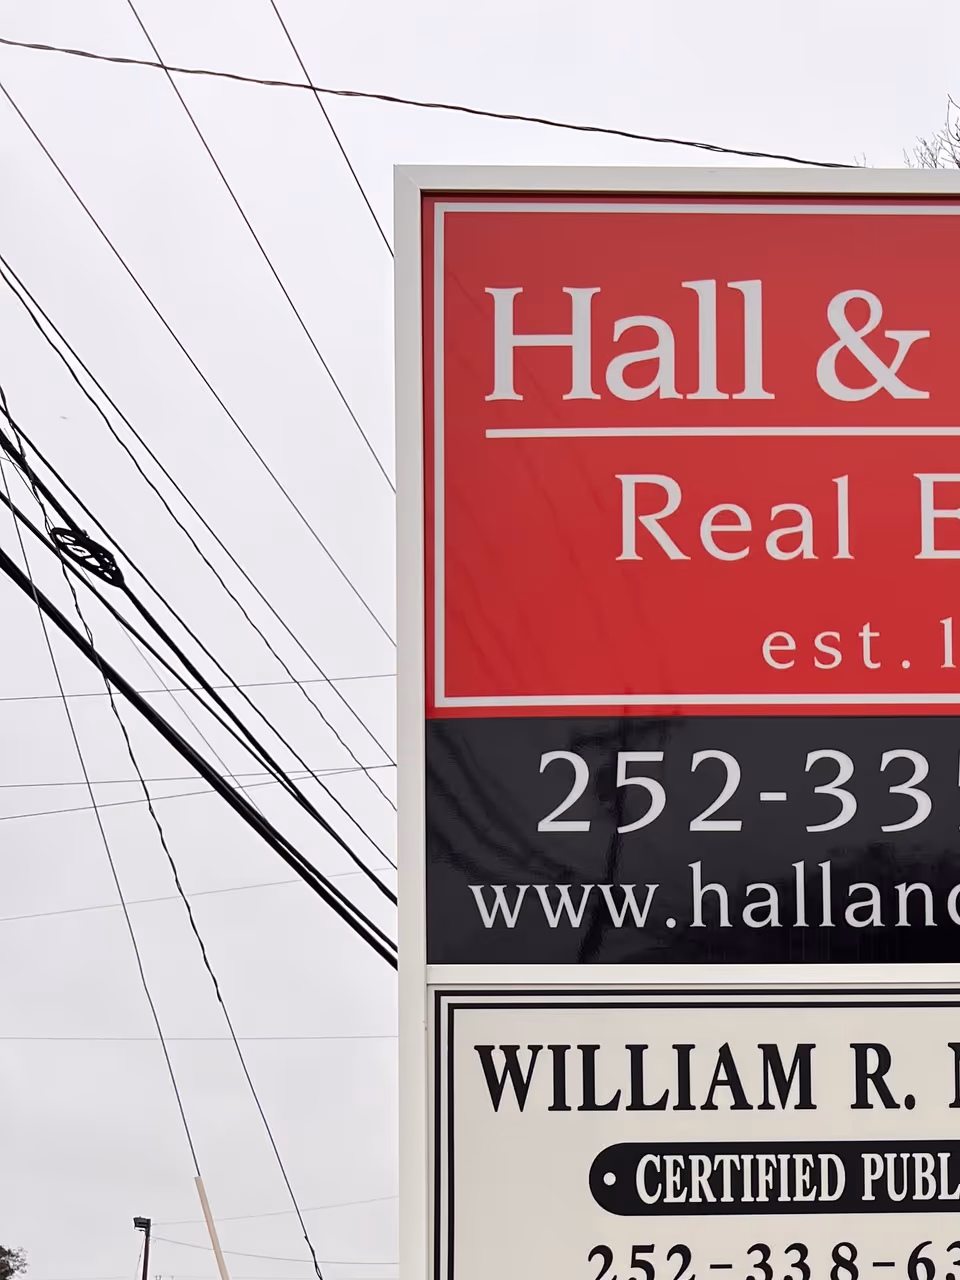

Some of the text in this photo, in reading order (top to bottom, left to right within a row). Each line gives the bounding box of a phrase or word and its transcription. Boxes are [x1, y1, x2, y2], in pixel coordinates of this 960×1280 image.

[485, 279, 776, 402] Hall
[816, 289, 931, 402] &
[615, 474, 854, 561] Real
[474, 1041, 818, 1113] WILLIAM
[850, 1042, 916, 1111] R.
[635, 1151, 846, 1205] CERTIFIED
